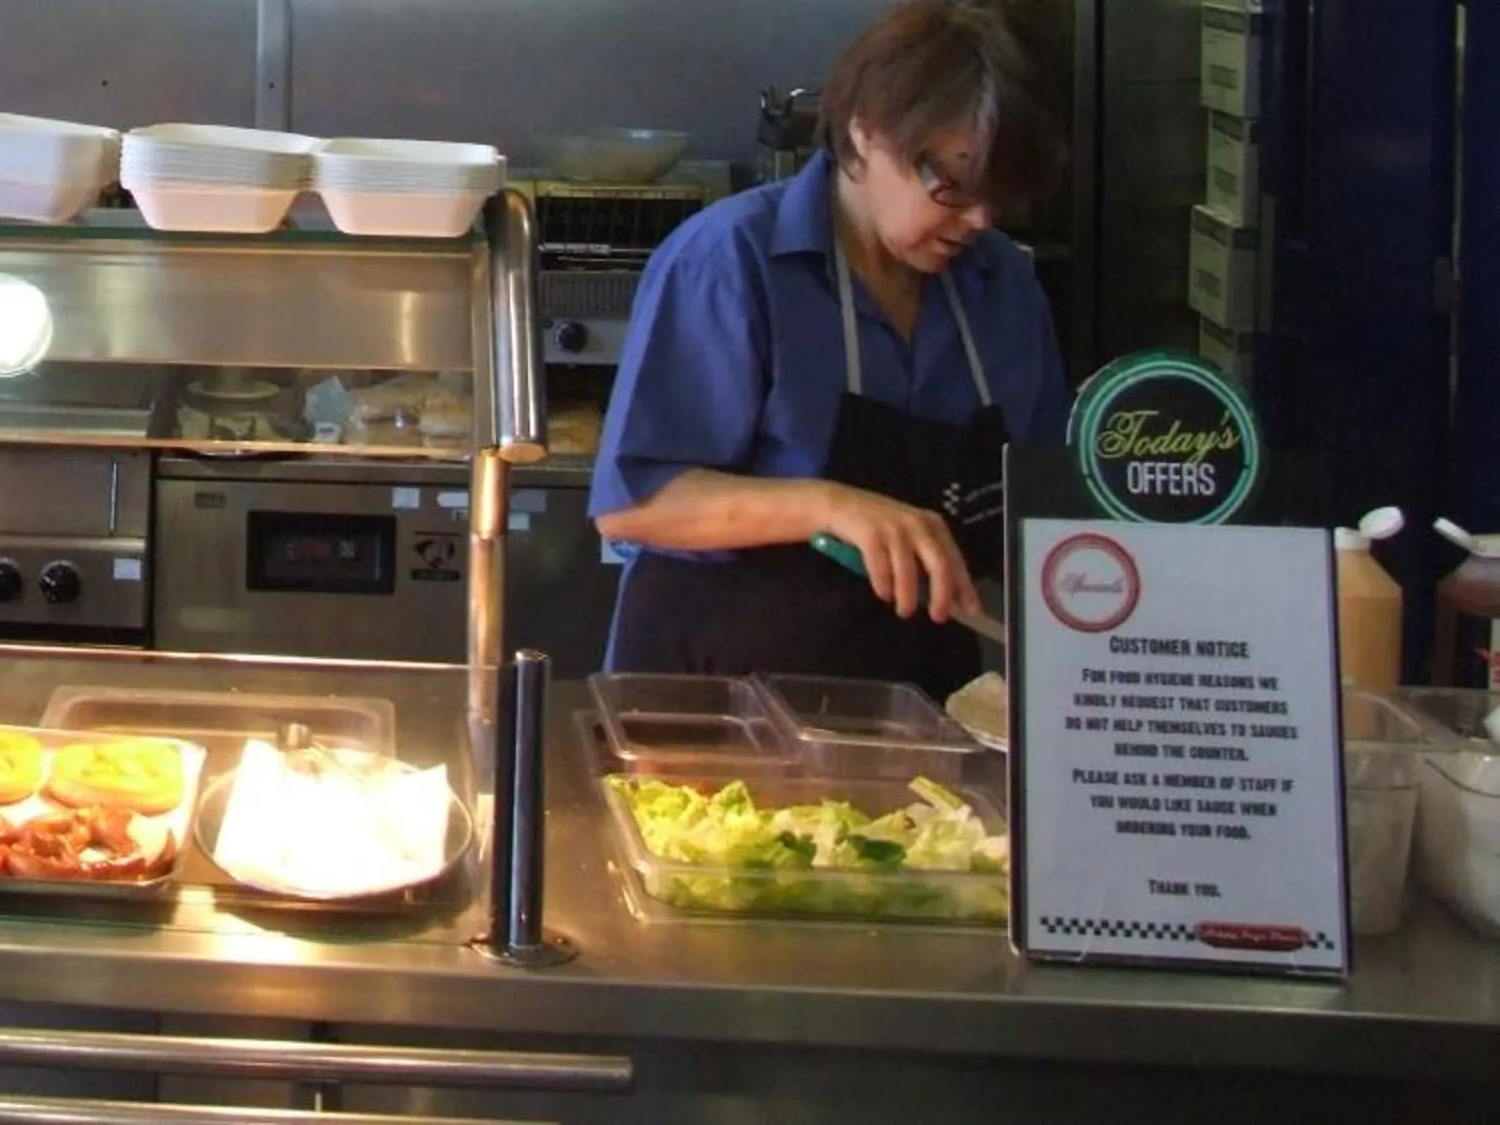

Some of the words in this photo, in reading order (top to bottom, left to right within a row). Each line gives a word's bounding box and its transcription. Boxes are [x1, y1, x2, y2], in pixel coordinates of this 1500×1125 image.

[1096, 410, 1239, 465] Today's
[1127, 462, 1216, 495] OFFERS
[1109, 636, 1190, 656] CUSTOMER
[1196, 640, 1250, 658] NOTICE
[1082, 669, 1106, 683] FOR
[1110, 670, 1141, 684] FOOD
[1144, 672, 1194, 686] HYGIENE
[1199, 674, 1255, 689] REASONS
[1258, 677, 1278, 690] WE
[1074, 693, 1116, 707] KINDLY
[1121, 695, 1174, 709] REQUEST
[1179, 697, 1209, 711] THAT
[1214, 699, 1288, 715] CUSTOMERS
[1066, 717, 1082, 730] DO
[1085, 717, 1109, 731] NOT
[1113, 719, 1143, 732] HELP
[1148, 720, 1226, 736] THEMSELVES
[1231, 724, 1246, 737] TO
[1250, 725, 1298, 739] SAUCES
[1114, 743, 1159, 757] BEHIND
[1162, 744, 1185, 758] THE
[1190, 746, 1249, 761] COUNTER.
[1073, 769, 1119, 785] PLEASE
[1123, 773, 1147, 786] ASK
[1152, 774, 1160, 786] A
[1164, 774, 1216, 789] MEMBER
[1220, 776, 1235, 790] OF
[1240, 778, 1277, 792] STAFF
[1281, 779, 1294, 793] IF
[1090, 795, 1114, 809] YOU
[1117, 797, 1161, 811] WOULD
[1165, 798, 1191, 812] LIKE
[1196, 800, 1236, 814] SAUCE
[1240, 802, 1277, 816] WHEN
[1115, 821, 1176, 836] ORDERING
[1180, 823, 1212, 837] YOUR
[1215, 825, 1250, 839] FOOD.
[1148, 879, 1189, 895] THANK
[1194, 883, 1221, 897] YOU.
